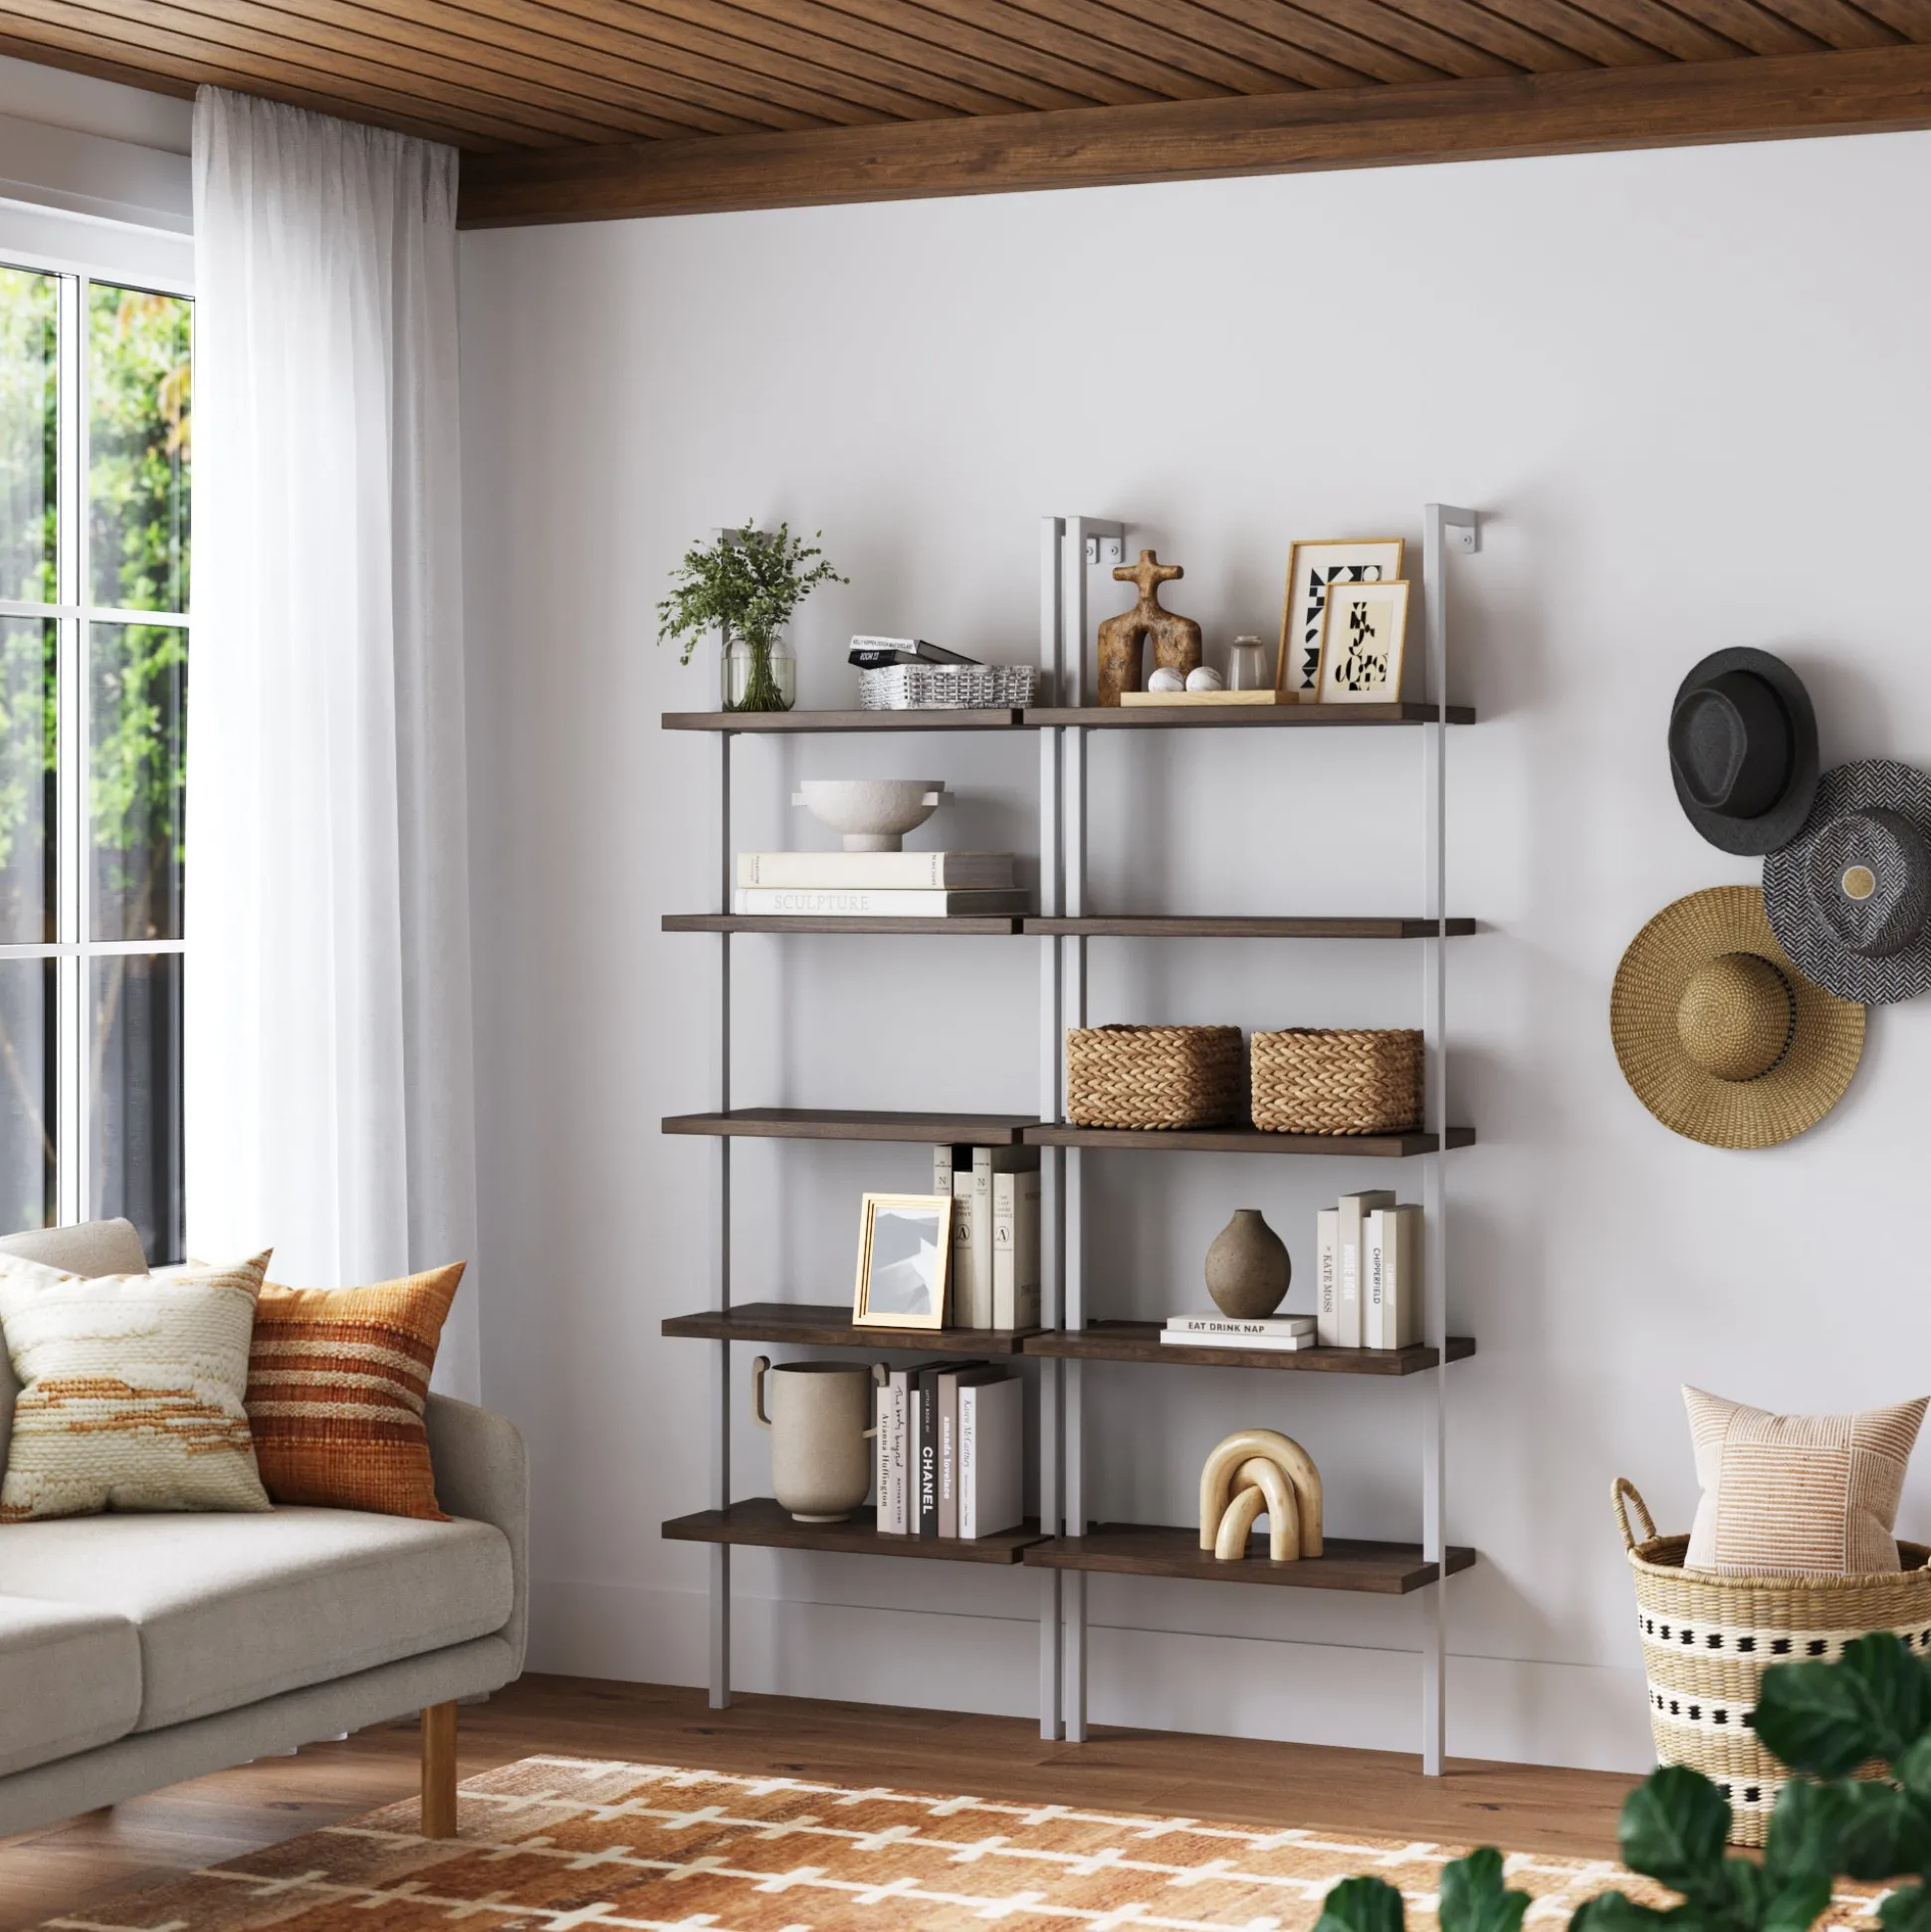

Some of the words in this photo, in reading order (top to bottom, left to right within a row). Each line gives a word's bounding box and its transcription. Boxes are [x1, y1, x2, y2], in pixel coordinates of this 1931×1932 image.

[774, 895, 870, 912] SCULPTURE
[1323, 1254, 1333, 1283] KATE
[1323, 1284, 1333, 1313] MOSS
[1187, 1321, 1206, 1331] EAT
[1209, 1323, 1241, 1332] DRINK
[1244, 1325, 1265, 1334] NAP
[895, 1407, 905, 1430] body
[943, 1415, 952, 1456] amanda
[891, 1434, 904, 1468] beyond
[963, 1426, 971, 1468] McCartney
[880, 1454, 889, 1507] Huffington
[922, 1446, 934, 1514] CHANEL
[943, 1458, 952, 1500] lovelace
